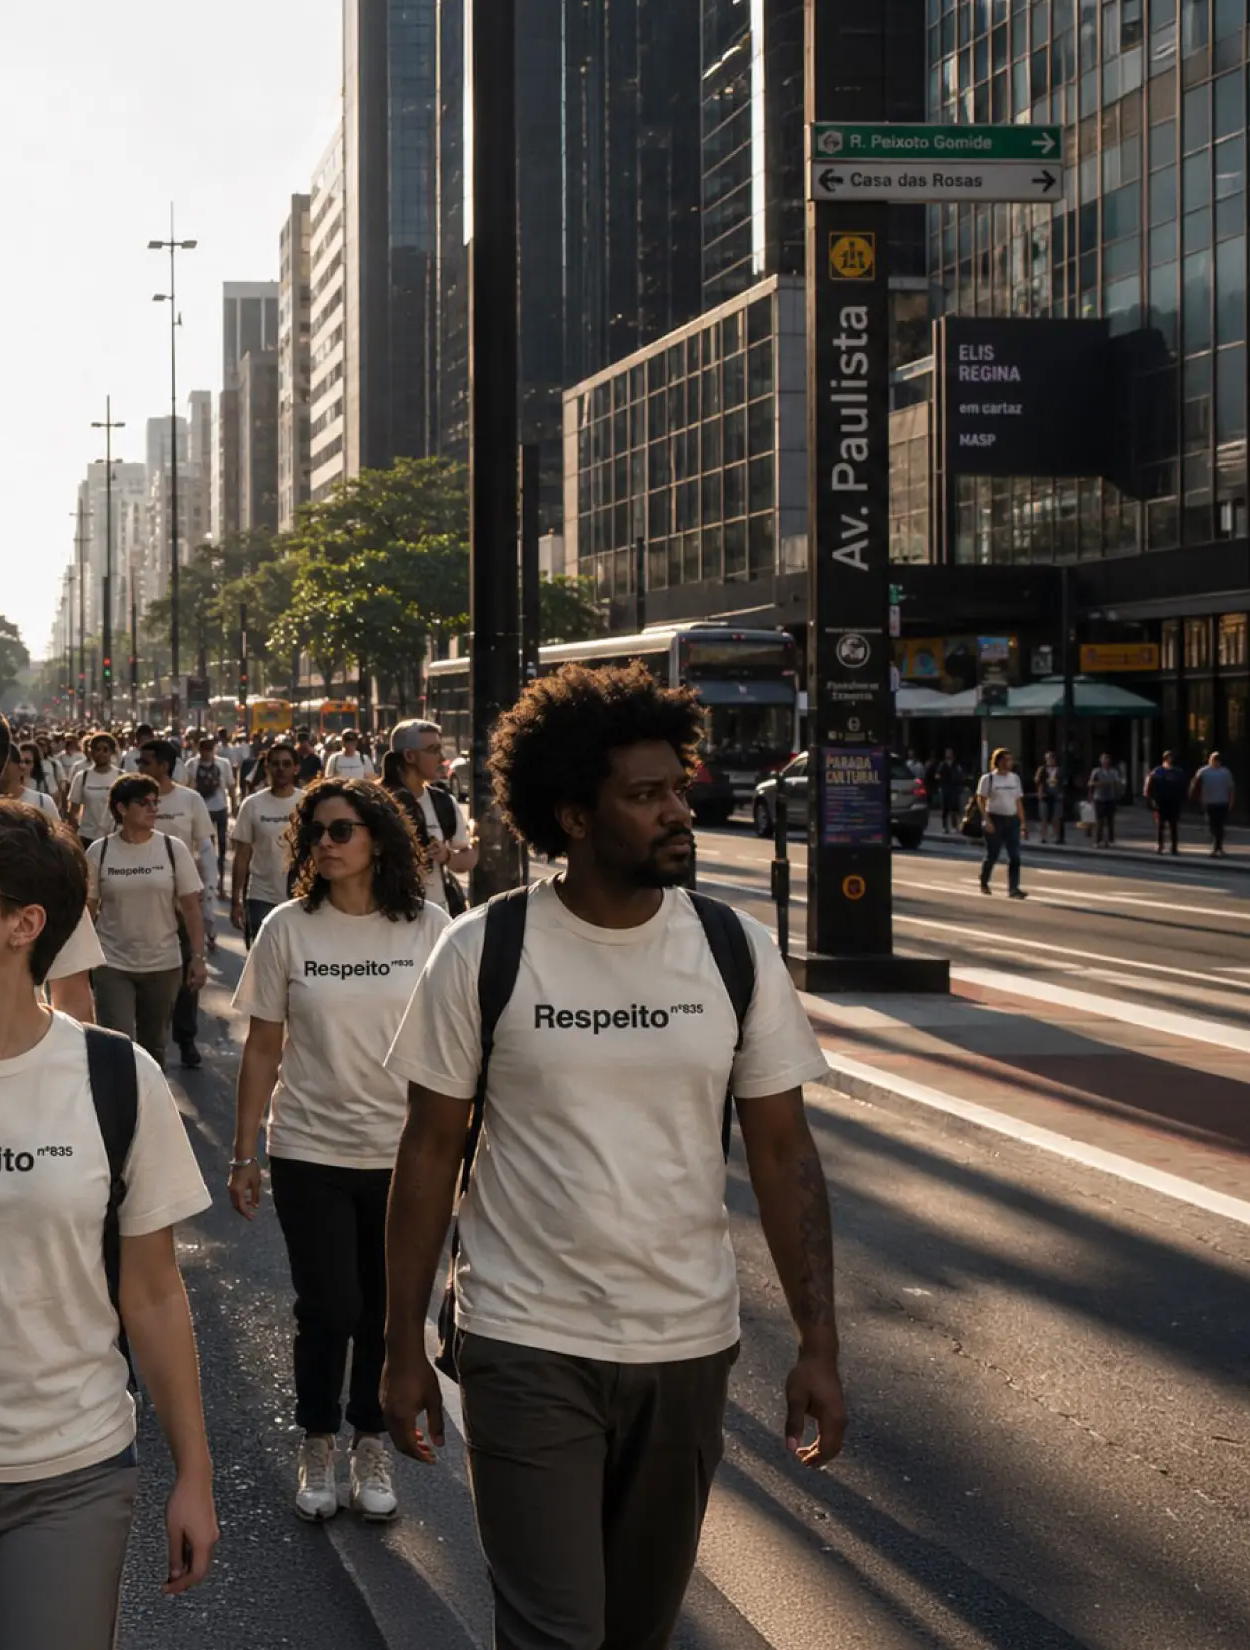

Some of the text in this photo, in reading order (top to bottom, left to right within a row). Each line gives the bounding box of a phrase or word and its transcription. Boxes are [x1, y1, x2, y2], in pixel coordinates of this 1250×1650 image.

[850, 134, 992, 150] R. Peixoto Gomide
[851, 172, 983, 187] Casa das Rosas
[959, 345, 995, 361] ELIS
[959, 365, 1021, 382] REGINA
[959, 402, 1023, 415] em cartaz
[829, 305, 870, 572] Av. Paulista
[959, 433, 996, 447] MASP
[304, 960, 390, 980] Respeito
[534, 1003, 669, 1035] Respeito
